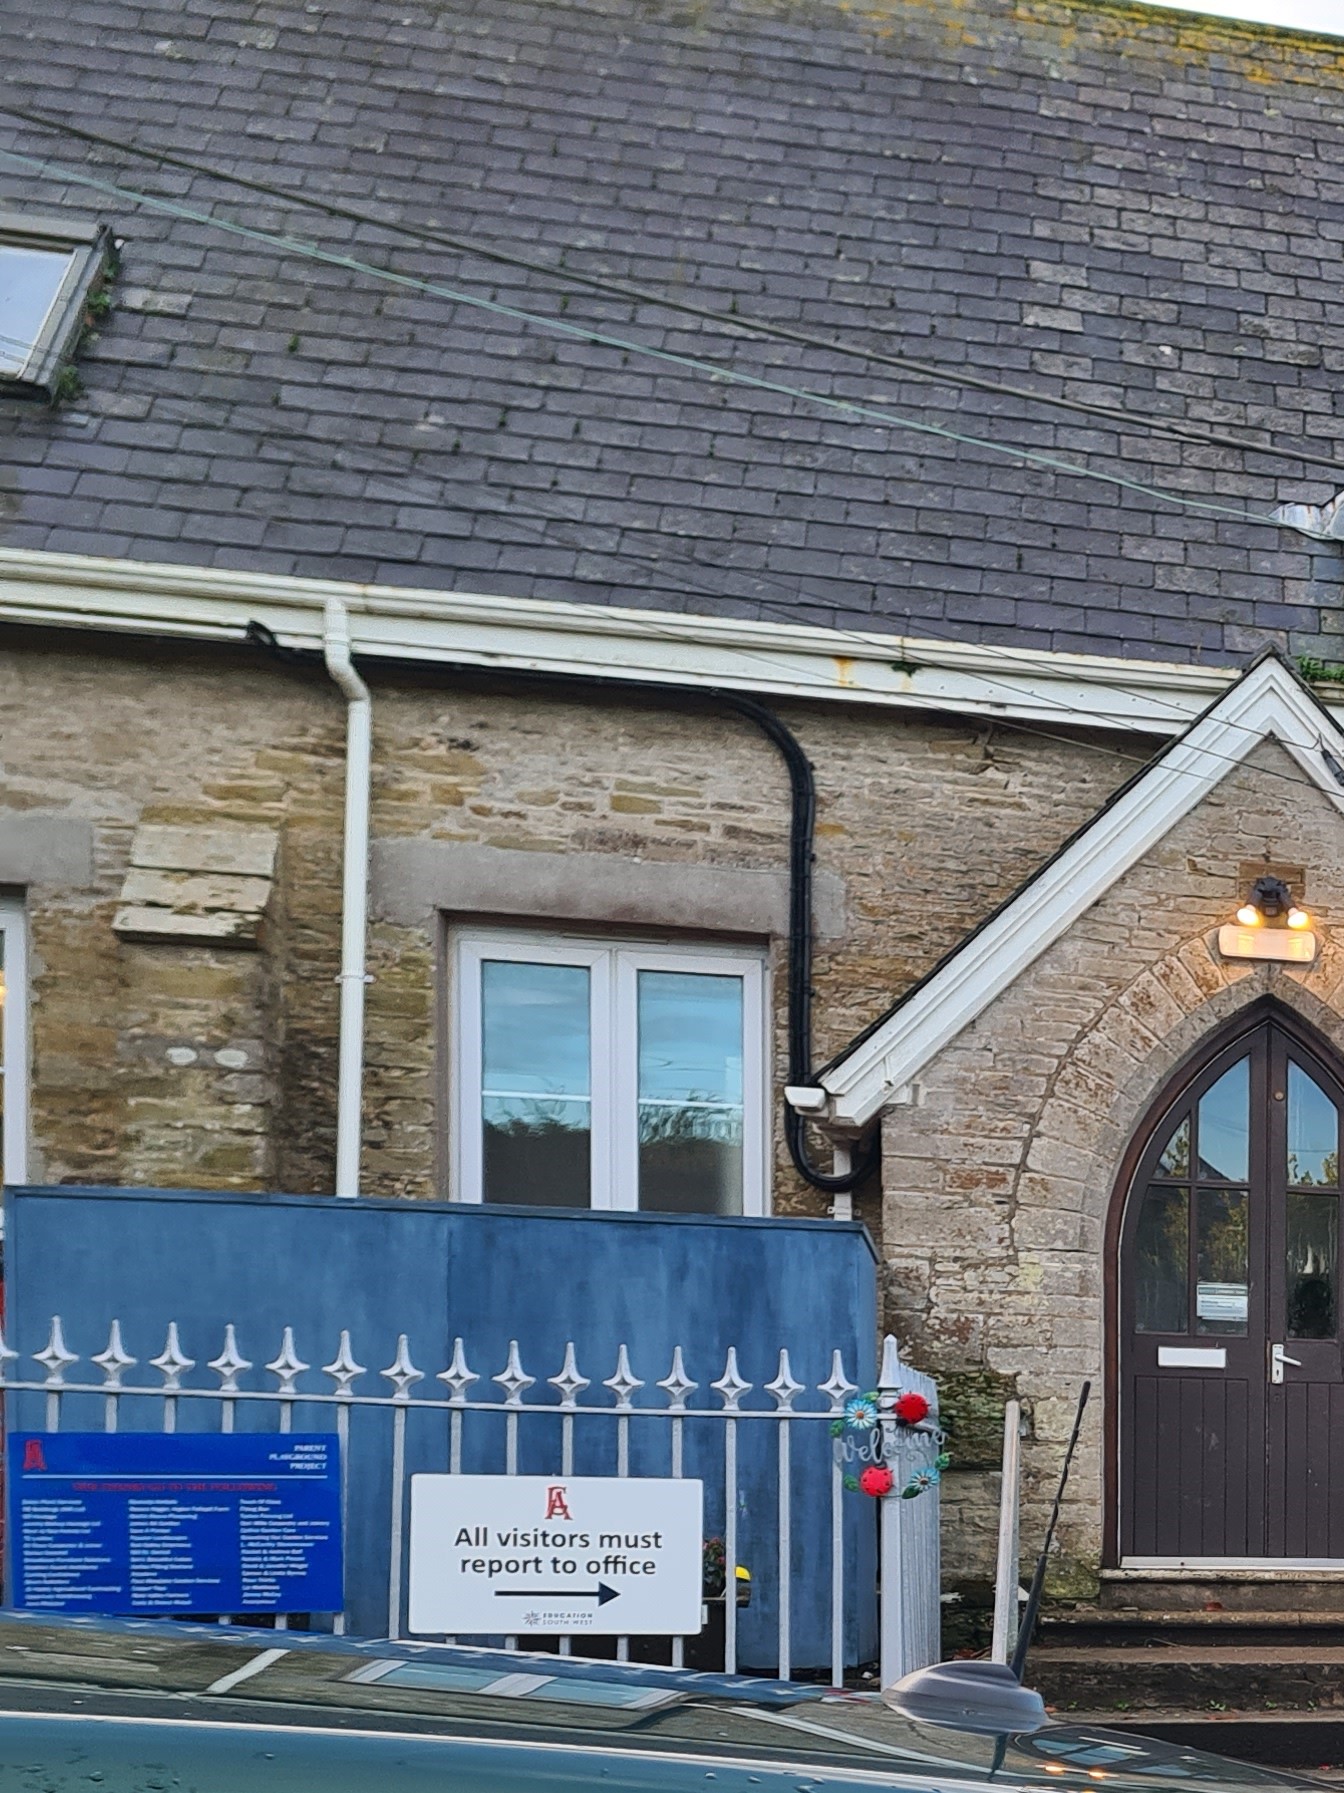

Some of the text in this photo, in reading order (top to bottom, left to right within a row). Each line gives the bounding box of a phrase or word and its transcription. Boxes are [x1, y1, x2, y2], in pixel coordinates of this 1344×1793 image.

[454, 1527, 662, 1549] All visitors must
[461, 1555, 656, 1578] report to office
